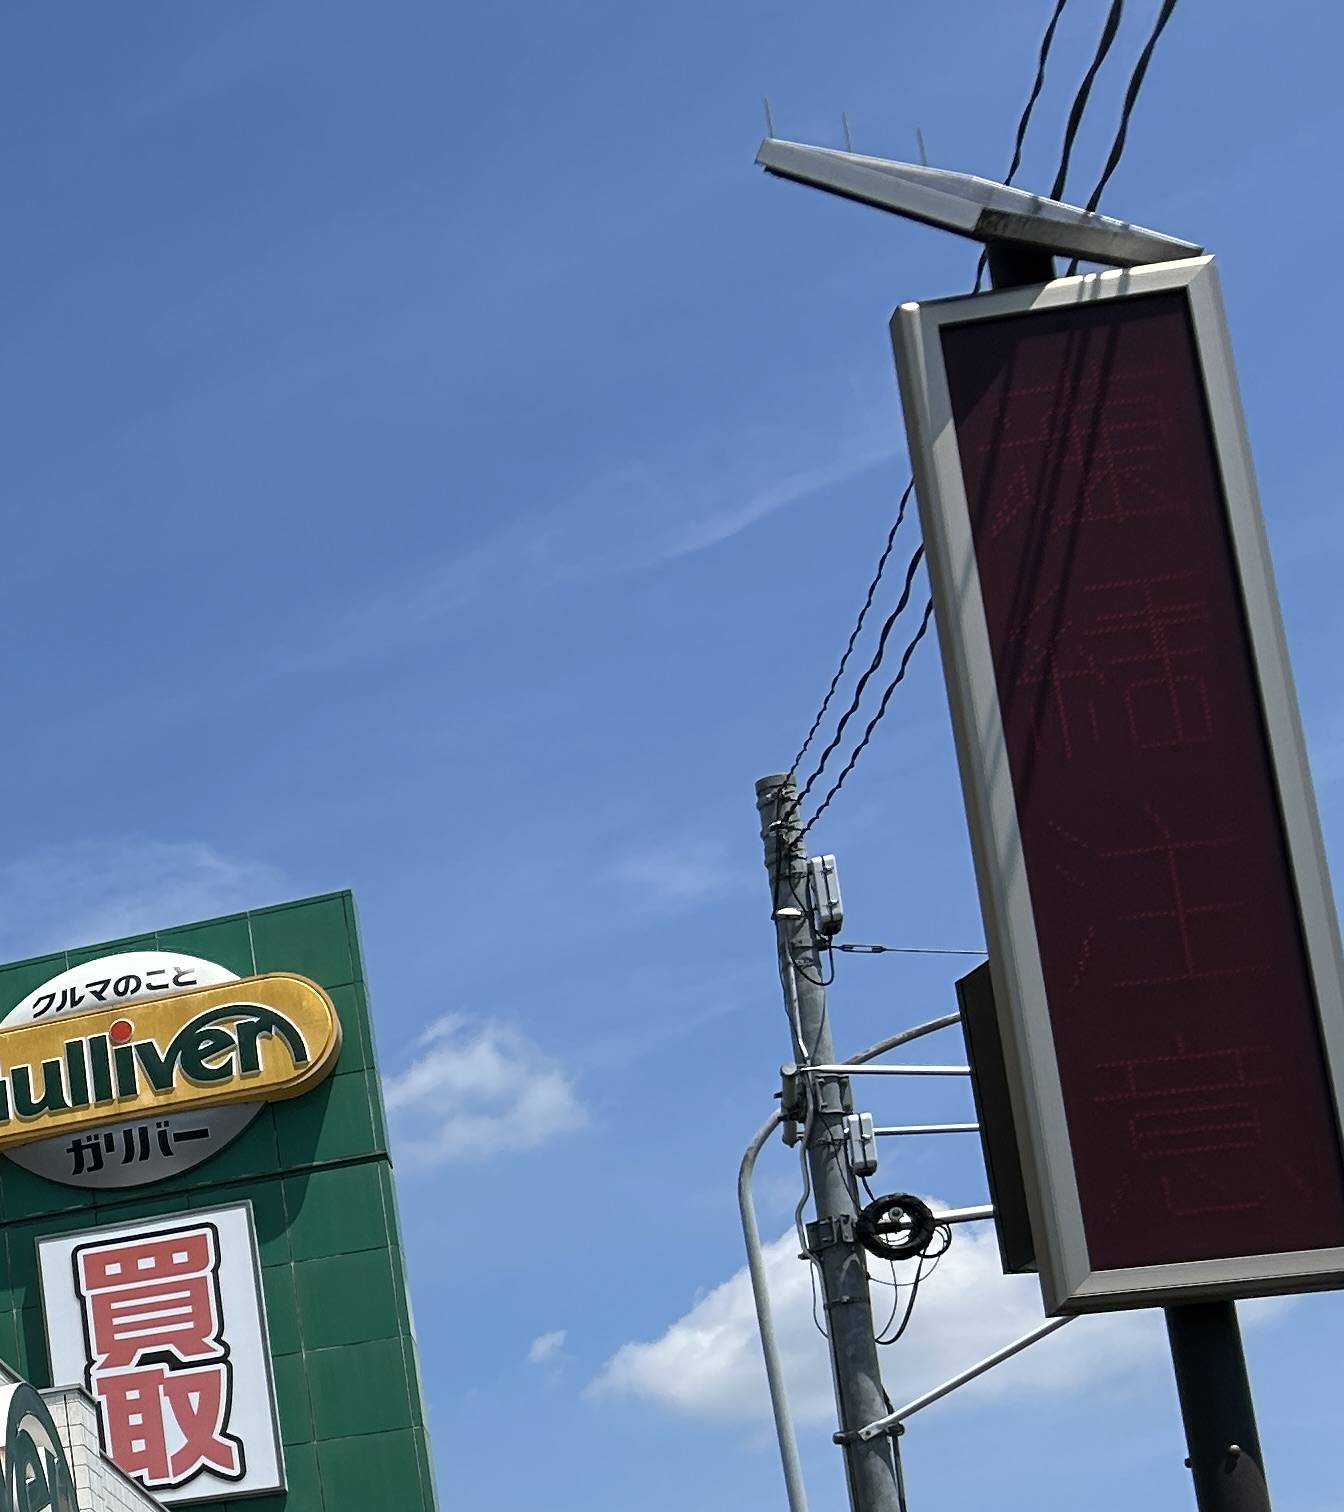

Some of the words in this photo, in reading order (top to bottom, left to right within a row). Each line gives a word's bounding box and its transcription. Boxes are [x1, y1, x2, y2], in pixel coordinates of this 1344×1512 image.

[32, 966, 198, 1018] クルマのこと
[66, 1121, 210, 1175] ガリバー
[74, 1224, 243, 1488] 買取
